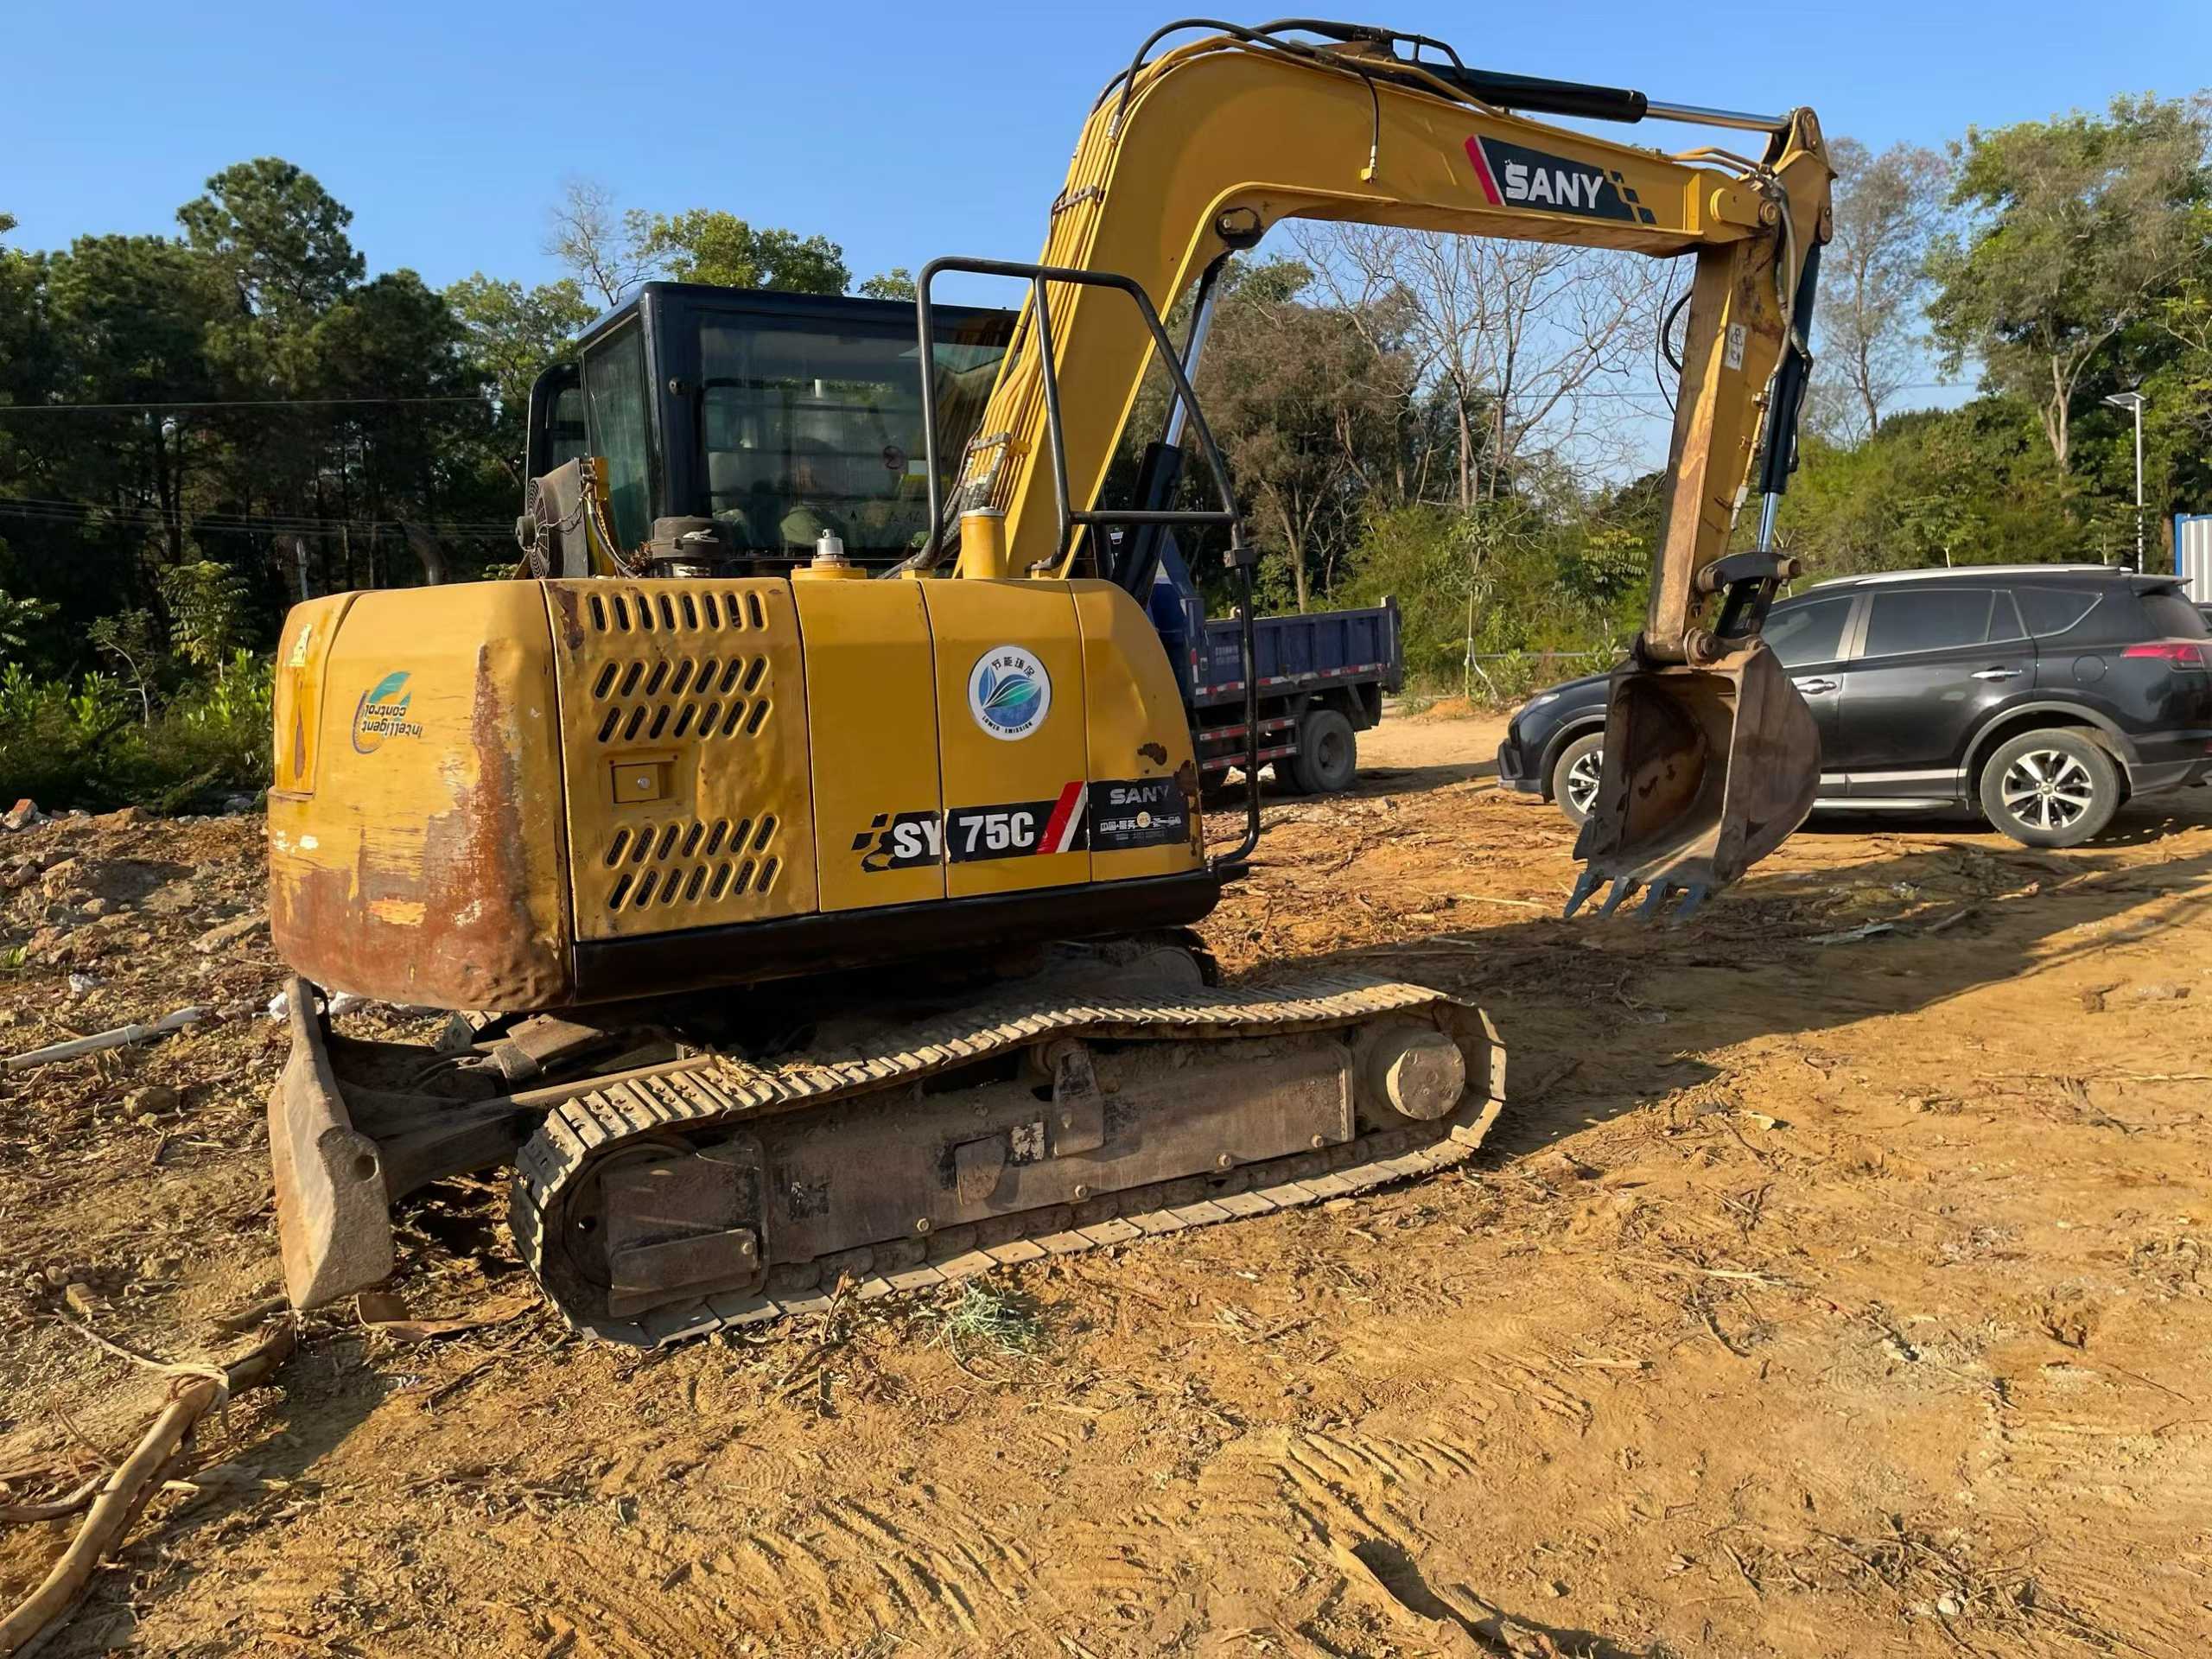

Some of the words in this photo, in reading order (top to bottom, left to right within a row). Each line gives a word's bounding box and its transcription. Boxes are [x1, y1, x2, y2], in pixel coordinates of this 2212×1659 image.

[1505, 162, 1604, 209] SANY
[365, 704, 407, 717] control
[361, 718, 423, 739] intelligent
[1109, 785, 1169, 805] SANY
